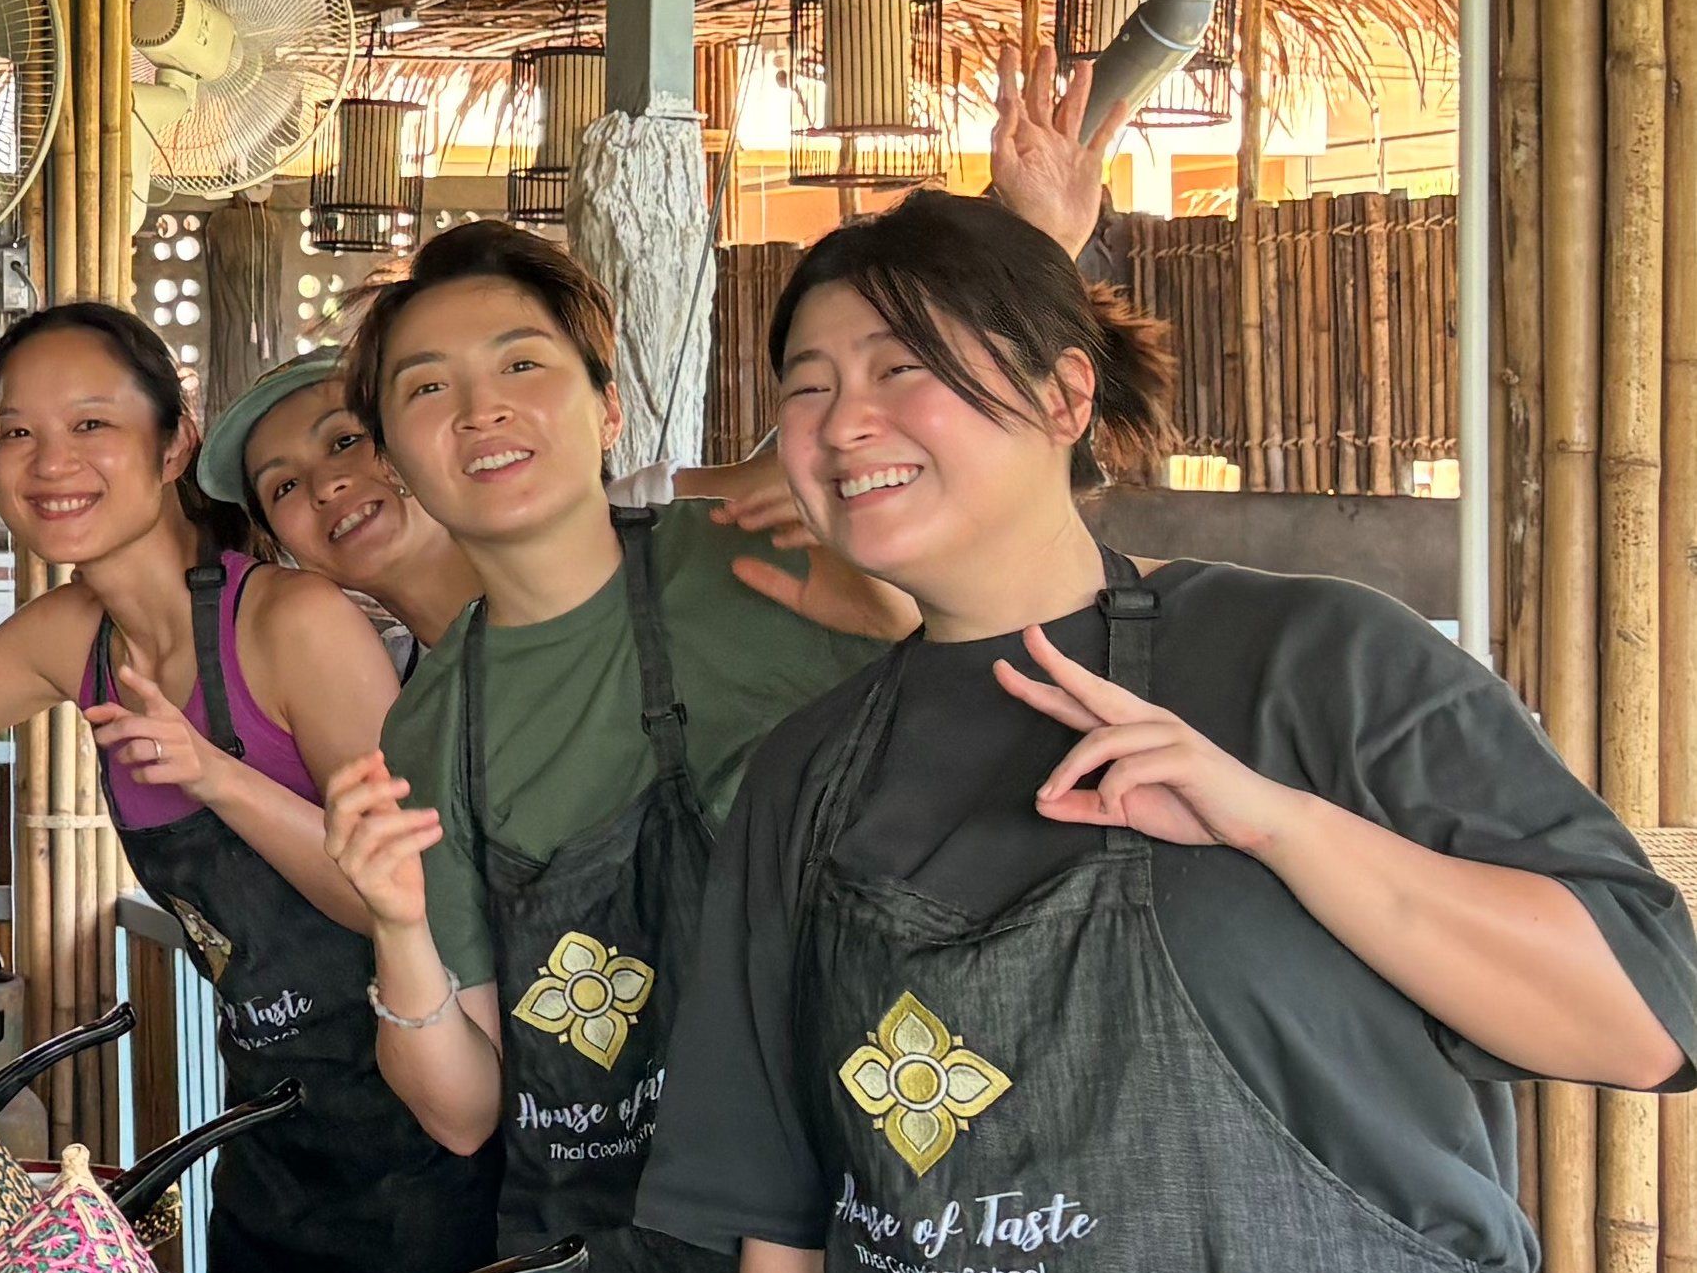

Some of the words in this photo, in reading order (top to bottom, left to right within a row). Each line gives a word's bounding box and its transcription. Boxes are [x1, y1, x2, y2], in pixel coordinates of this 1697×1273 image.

[239, 989, 313, 1027] Taste
[516, 1093, 609, 1133] House
[550, 1142, 585, 1161] Thai
[912, 1201, 963, 1258] of
[974, 1191, 1099, 1253] Taste
